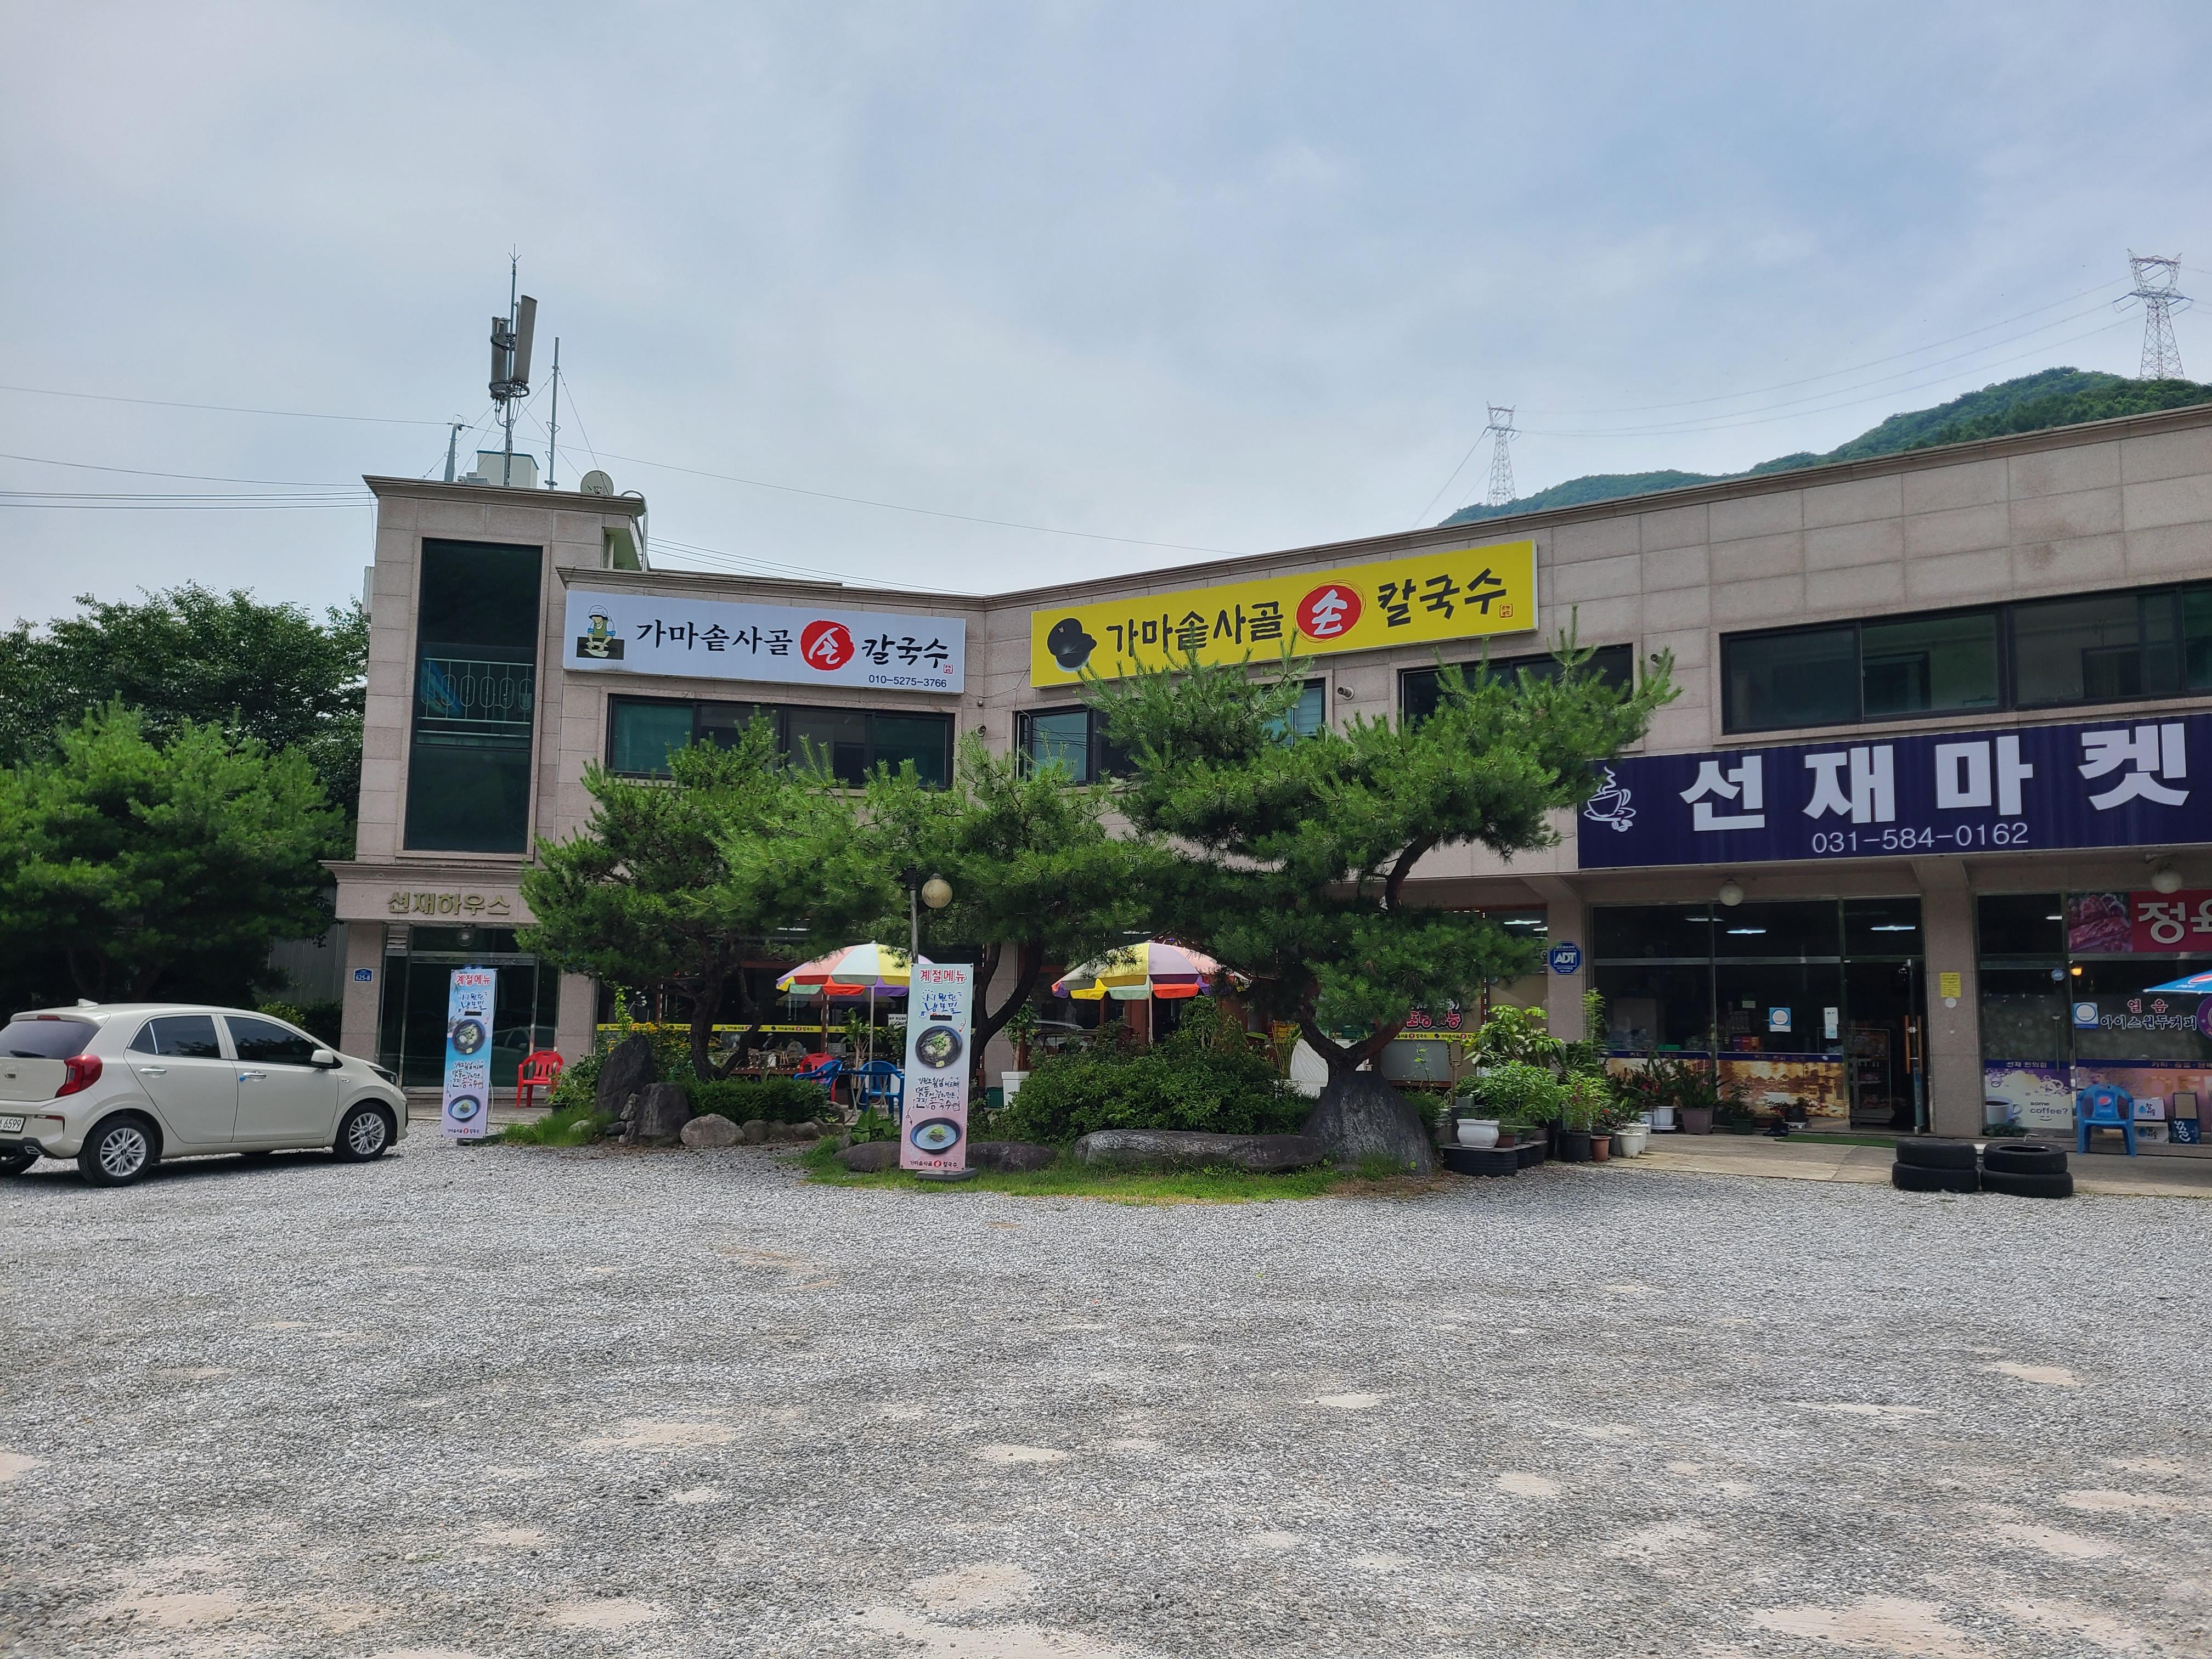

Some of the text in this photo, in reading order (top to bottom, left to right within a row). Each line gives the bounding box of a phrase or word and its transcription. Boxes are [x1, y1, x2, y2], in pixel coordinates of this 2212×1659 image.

[1106, 567, 1506, 658] 가마솥사골 손 칼국수
[636, 618, 793, 657] 가마솥사골
[861, 634, 949, 669] 칼국수
[868, 674, 947, 687] 010-5275-3766
[1679, 723, 2190, 832] 선재마켓
[1811, 822, 2029, 855] 031-584-0162
[387, 891, 510, 915] 선재하우스
[1554, 952, 1576, 963] ADT
[456, 973, 492, 985] 계절메뉴
[920, 969, 966, 984] 계절메뉴
[926, 991, 957, 1002] 시원한
[924, 1002, 962, 1014] 냉모밀
[2100, 1014, 2197, 1031] 아이스원두커피
[3, 1119, 21, 1128] 6599
